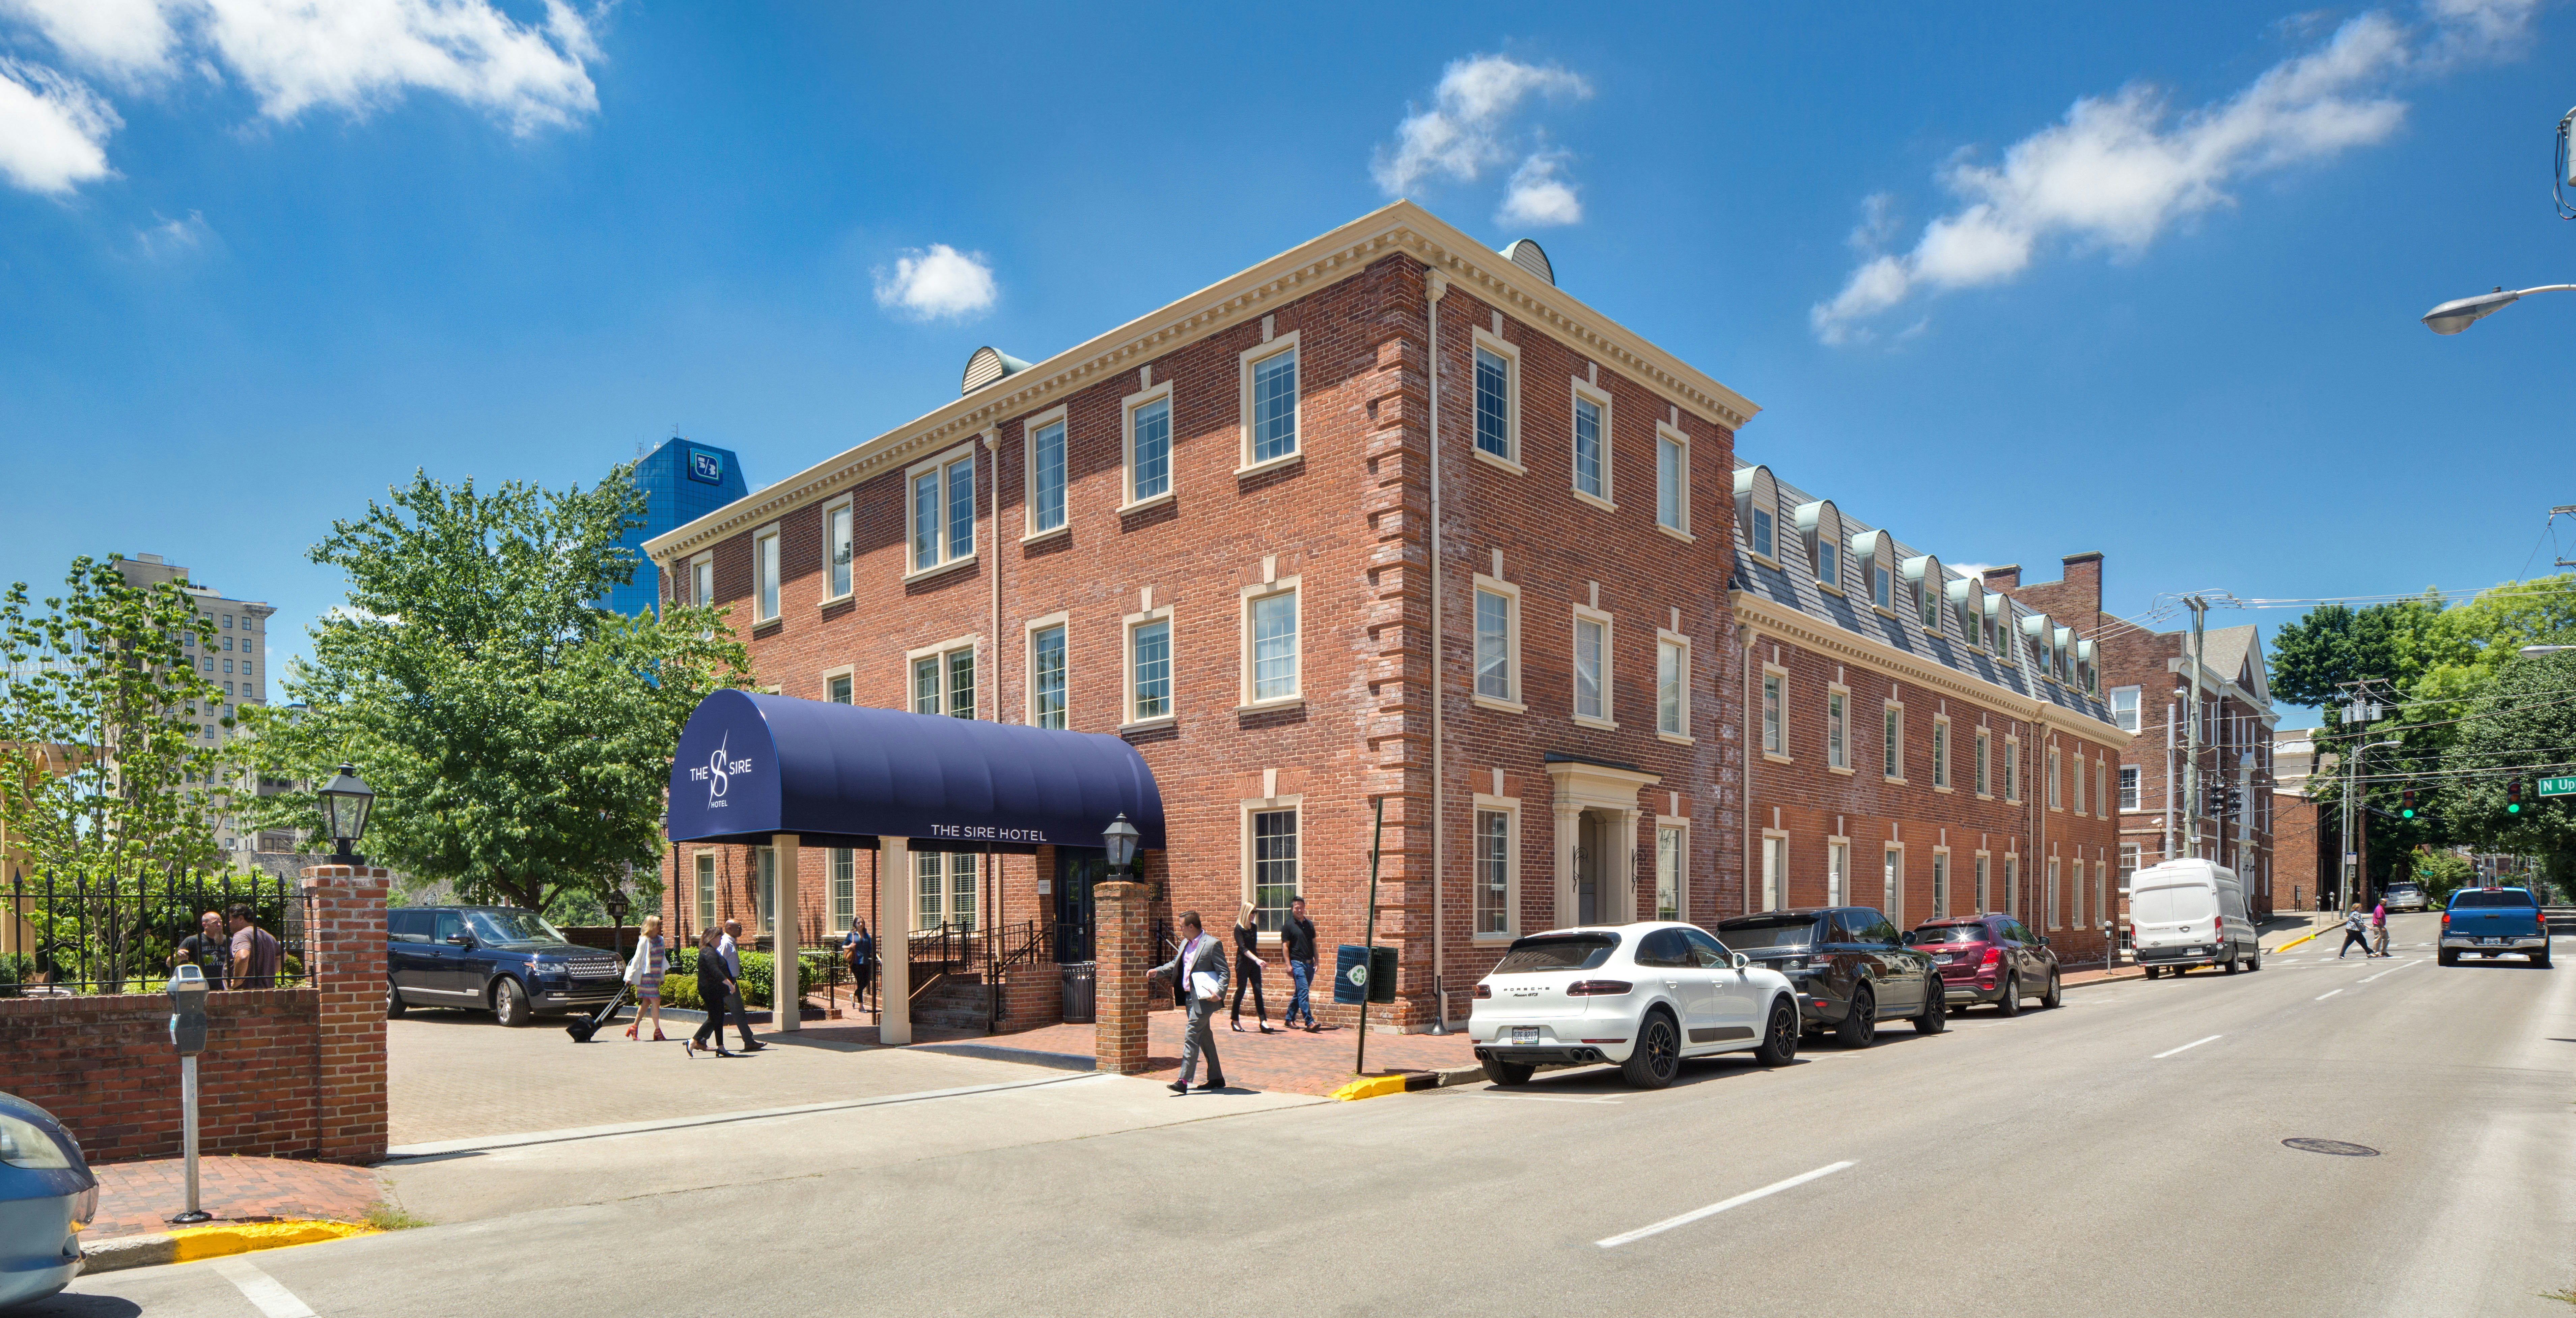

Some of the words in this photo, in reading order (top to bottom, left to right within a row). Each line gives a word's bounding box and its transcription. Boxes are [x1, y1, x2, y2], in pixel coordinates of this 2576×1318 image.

[690, 766, 708, 781] THE
[729, 758, 752, 775] SIRE
[2543, 780, 2552, 791] N
[2558, 779, 2576, 791] Up
[711, 800, 728, 808] HOTEL
[931, 825, 960, 836] THE
[964, 826, 995, 838] SIRE
[1000, 829, 1047, 841] HOTEL
[1524, 1031, 1537, 1040] 8217
